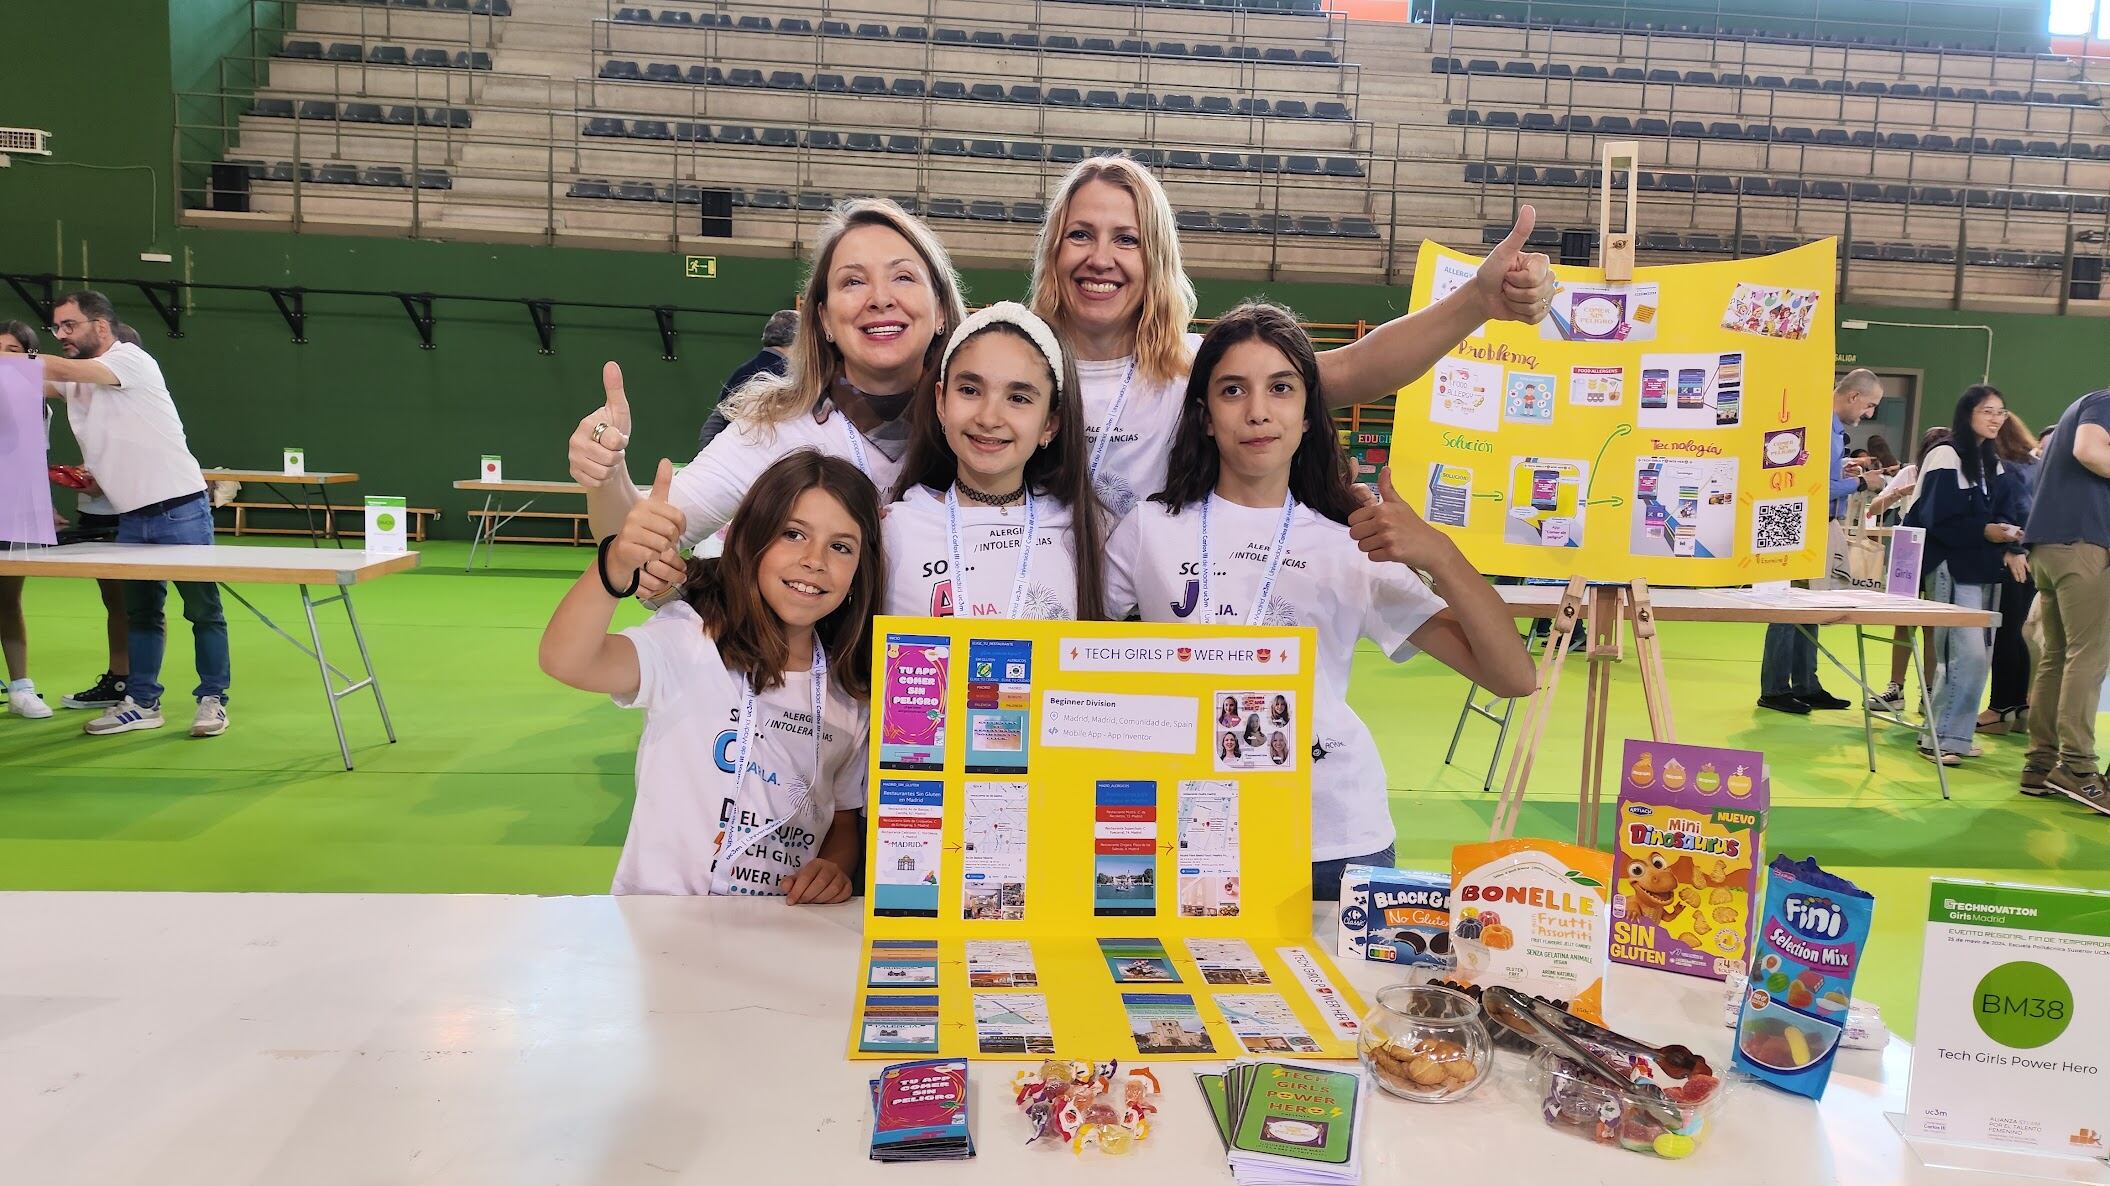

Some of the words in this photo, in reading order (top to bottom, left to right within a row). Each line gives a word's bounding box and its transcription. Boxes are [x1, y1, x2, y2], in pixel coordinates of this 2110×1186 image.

[1458, 339, 1540, 370] Problema
[1835, 353, 1857, 362] SALIDA
[979, 537, 1052, 552] INTOLERIAS
[1262, 581, 1271, 598] uc3m
[1278, 527, 1288, 545] Carlos
[1895, 567, 1912, 580] Girls
[1085, 647, 1120, 660] TECH
[1124, 647, 1162, 660] GIRLS
[898, 666, 914, 675] TU
[914, 667, 937, 676] APP
[898, 676, 936, 686] COMER
[906, 687, 926, 695] SIN
[892, 696, 939, 706] PELIGRO
[1050, 697, 1085, 708] Beginner
[1086, 699, 1116, 708] Division
[783, 710, 814, 724] ALERG
[1063, 714, 1090, 723] Madrid,
[1091, 715, 1118, 725] Madrid,
[1118, 717, 1160, 727] Comunidad
[1173, 720, 1193, 730] Spain
[770, 719, 833, 743] INTOLERAIAS
[1062, 728, 1087, 738] Mobile
[1087, 730, 1102, 740] App
[1107, 731, 1121, 742] App
[1122, 732, 1152, 741] Inventor
[1629, 807, 1653, 815] ARTIACH
[1717, 812, 1756, 825] NUEVO
[1668, 819, 1701, 834] Mini
[1628, 822, 1741, 859] Dinosaurus
[1461, 884, 1596, 917] BONELLE
[1951, 901, 2038, 917] TECHNOVATION
[1343, 916, 1365, 927] Classic
[1388, 910, 1409, 924] No
[1537, 912, 1592, 931] Frutti
[1786, 897, 1842, 938] Fini
[1949, 911, 1972, 921] Girls
[1972, 912, 2006, 924] Madrid
[1537, 926, 1592, 942] Assortiti
[1613, 921, 1656, 949] SIN
[1948, 928, 1984, 937] EVENTO
[1984, 931, 2027, 941] REGIONAL
[2058, 937, 2110, 948] TEMPORADA
[1610, 943, 1666, 966] GLUTEN
[1769, 928, 1820, 963] Selection
[1822, 948, 1850, 967] Mix
[1526, 949, 1543, 958] SENZA
[1544, 951, 1569, 960] GELATINA
[1570, 954, 1593, 964] ANIMALE
[1981, 993, 2065, 1021] BM38
[1938, 1048, 1972, 1062] Tech
[1975, 1051, 2007, 1066] Girls
[2011, 1055, 2057, 1072] Power
[2062, 1060, 2099, 1075] Hero
[899, 1078, 920, 1086] TU
[1283, 1071, 1328, 1083] TECH
[899, 1081, 950, 1092] COMER
[1276, 1081, 1329, 1093] GIRLS
[891, 1093, 956, 1105] PELIGRO
[1924, 1108, 1948, 1117] uc3m
[1989, 1116, 2017, 1125] ALIANZA
[1988, 1127, 2023, 1136] FEMENINO
[2012, 1124, 2042, 1133] TALENTO
